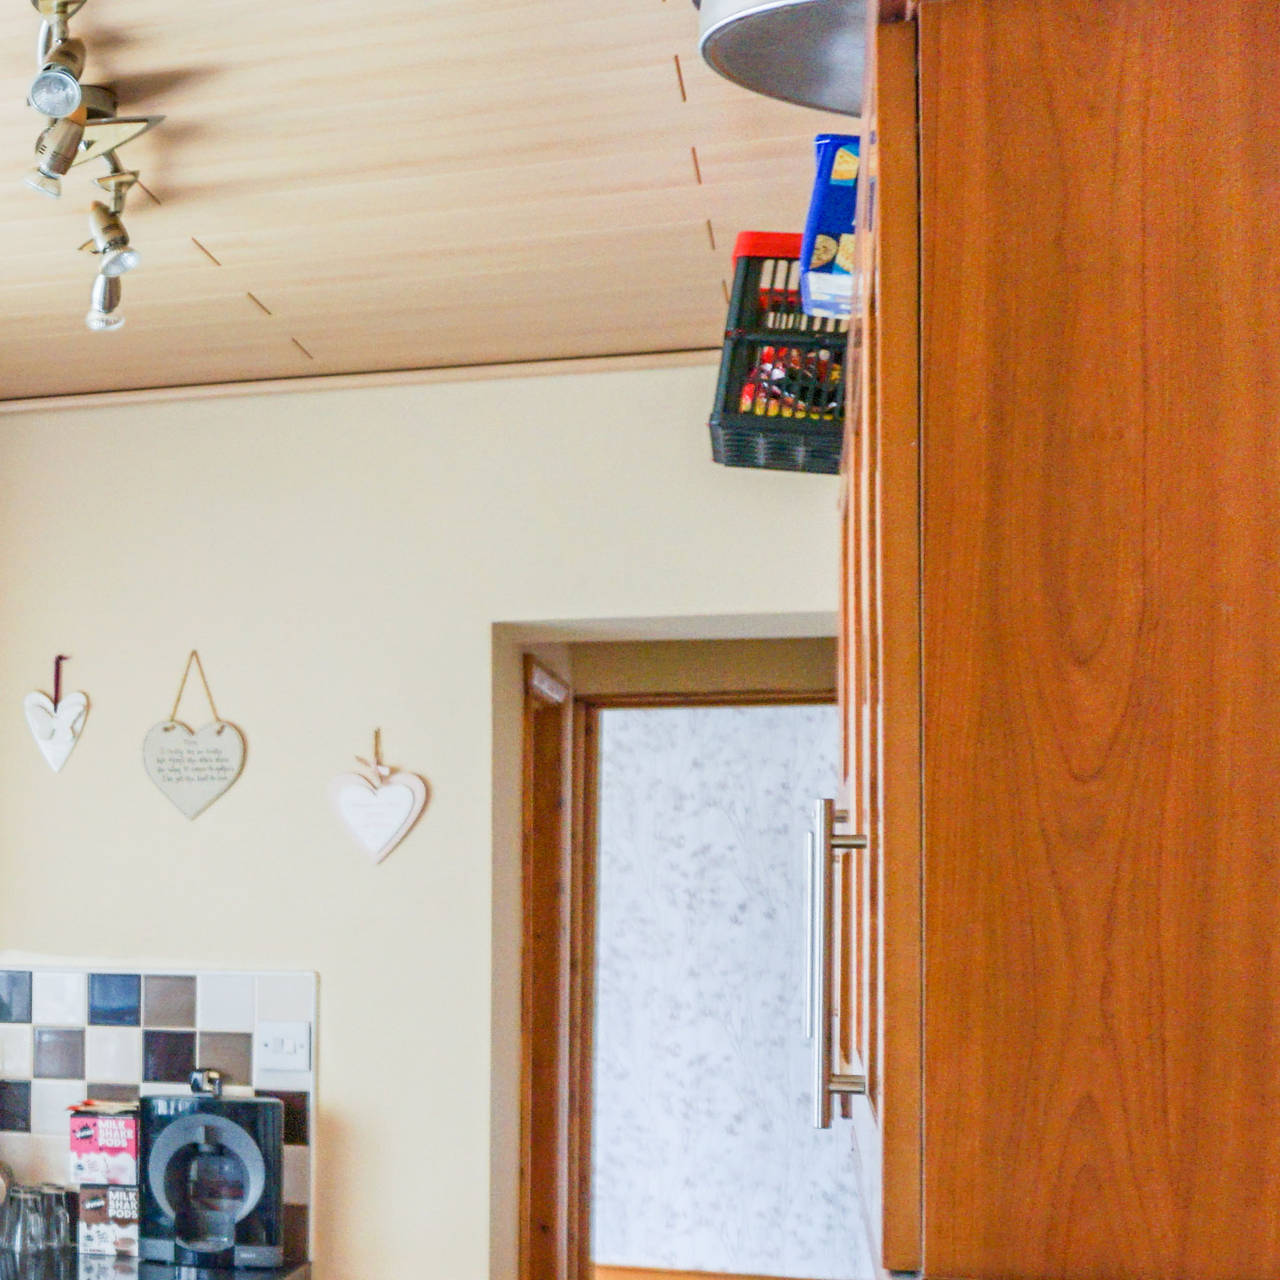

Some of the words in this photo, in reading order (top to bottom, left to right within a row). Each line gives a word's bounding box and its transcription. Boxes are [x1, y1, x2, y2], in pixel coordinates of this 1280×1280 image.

[98, 1119, 126, 1129] MILK
[98, 1128, 134, 1139] SHAKE
[98, 1138, 128, 1148] PODS
[108, 1191, 137, 1201] MILK
[108, 1199, 138, 1210] SHAK
[108, 1208, 138, 1219] PODS
